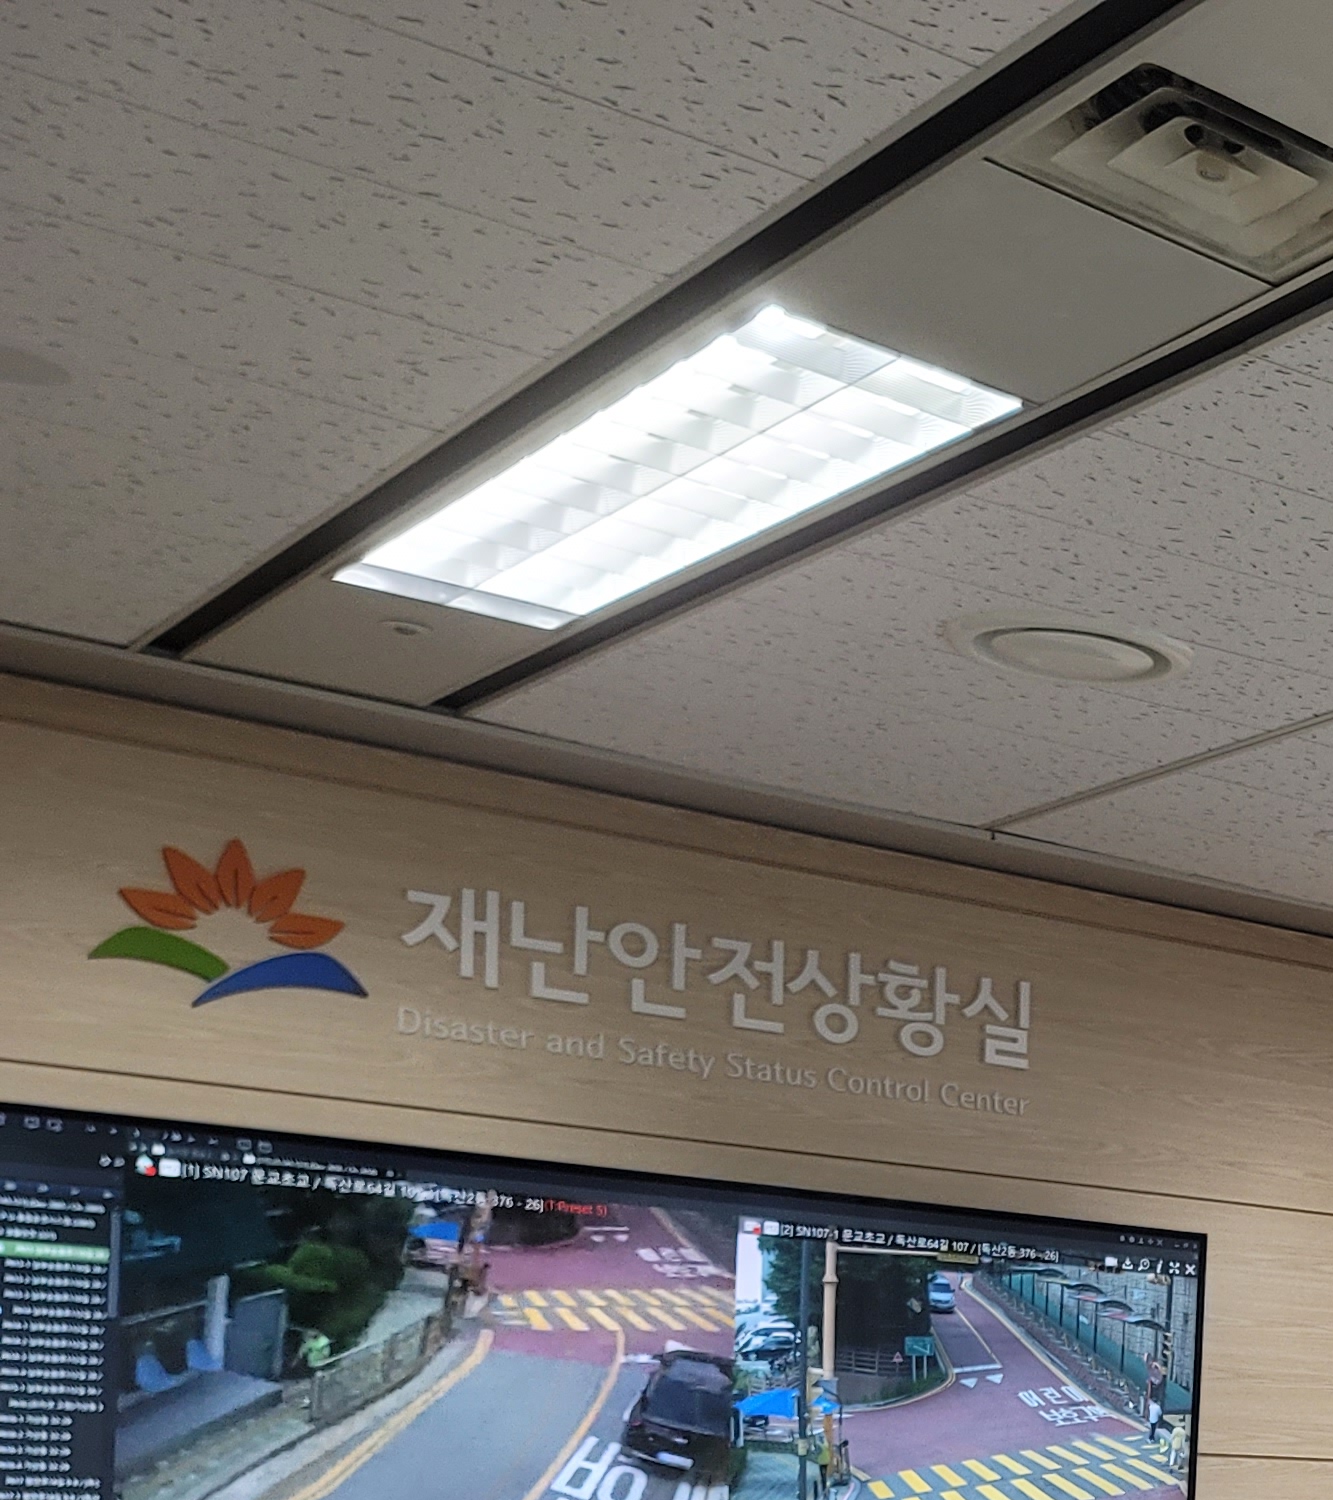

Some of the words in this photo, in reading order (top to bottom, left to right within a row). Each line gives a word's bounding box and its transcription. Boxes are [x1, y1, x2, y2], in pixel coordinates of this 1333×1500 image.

[402, 887, 1031, 1069] 재난안전상황실
[397, 1007, 533, 1050] Disaster
[546, 1032, 604, 1060] and
[618, 1038, 715, 1080] Safety
[725, 1053, 817, 1088] Status
[827, 1068, 929, 1103] Control
[940, 1083, 1031, 1117] Center
[780, 1223, 793, 1238] [2]
[795, 1226, 839, 1241] SN107-1
[842, 1229, 886, 1245] 문교초교
[895, 1234, 949, 1252] 독산로64길
[952, 1240, 969, 1253] 107
[1019, 1247, 1036, 1259] 376
